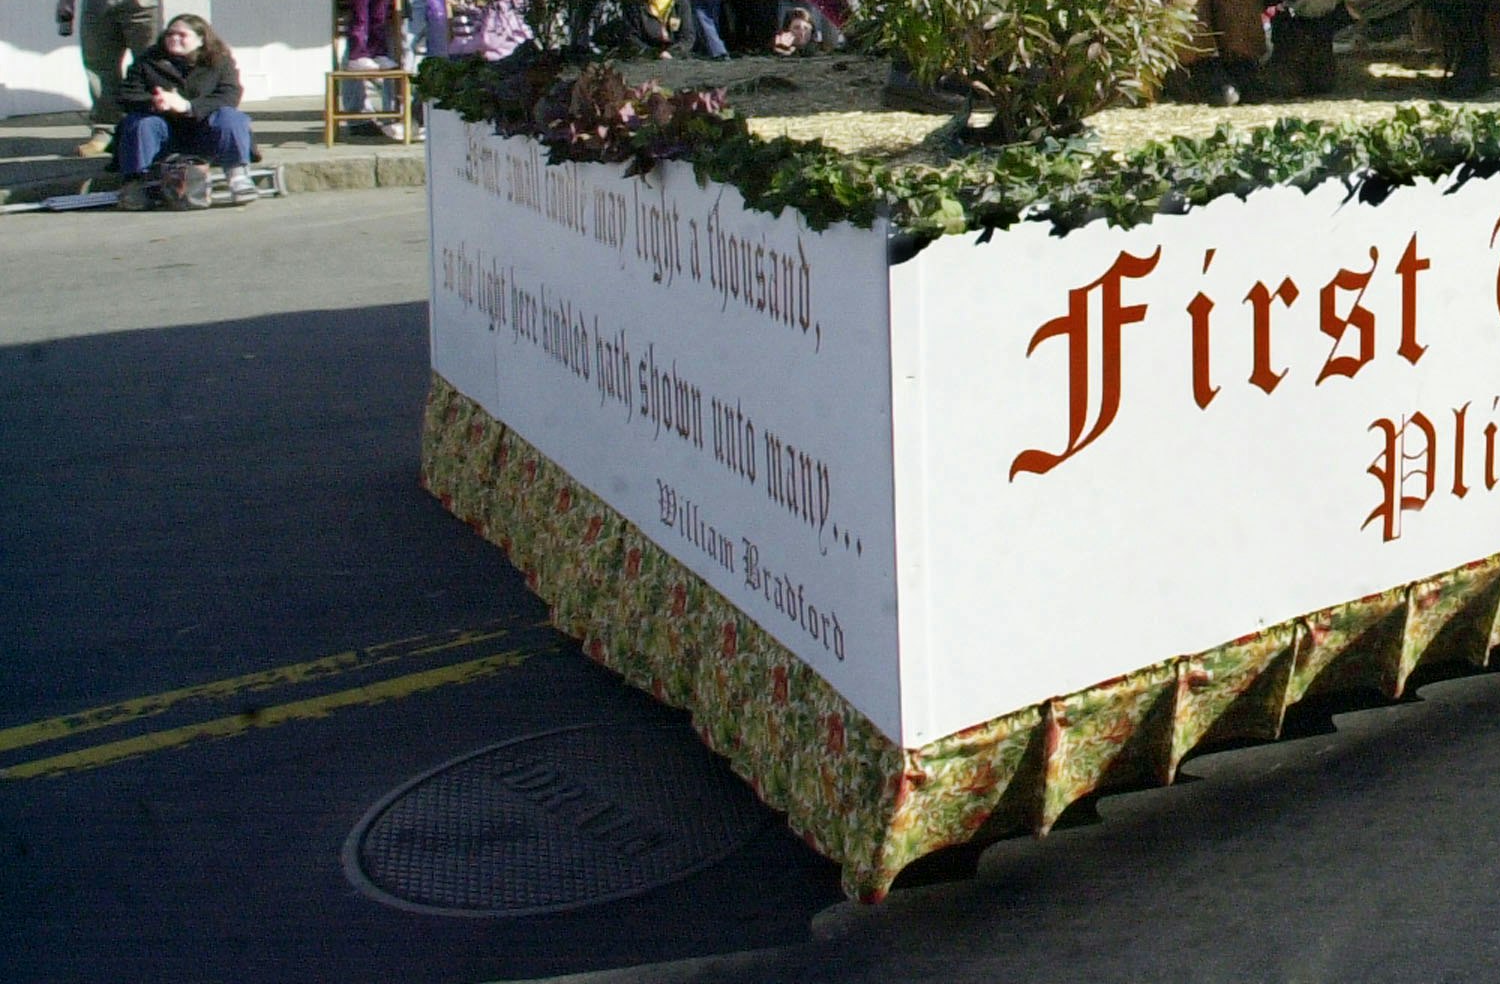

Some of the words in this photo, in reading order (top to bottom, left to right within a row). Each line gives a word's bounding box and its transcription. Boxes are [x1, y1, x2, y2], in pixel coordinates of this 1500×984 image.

[593, 186, 627, 269] may
[634, 179, 682, 287] light
[690, 218, 701, 283] a
[477, 248, 507, 332] light
[511, 266, 538, 345] here
[541, 283, 590, 383] kindled
[595, 315, 633, 424] hath
[712, 396, 757, 486] unto
[1008, 235, 1431, 479] First
[656, 478, 735, 574] William
[742, 537, 845, 662] Bradford
